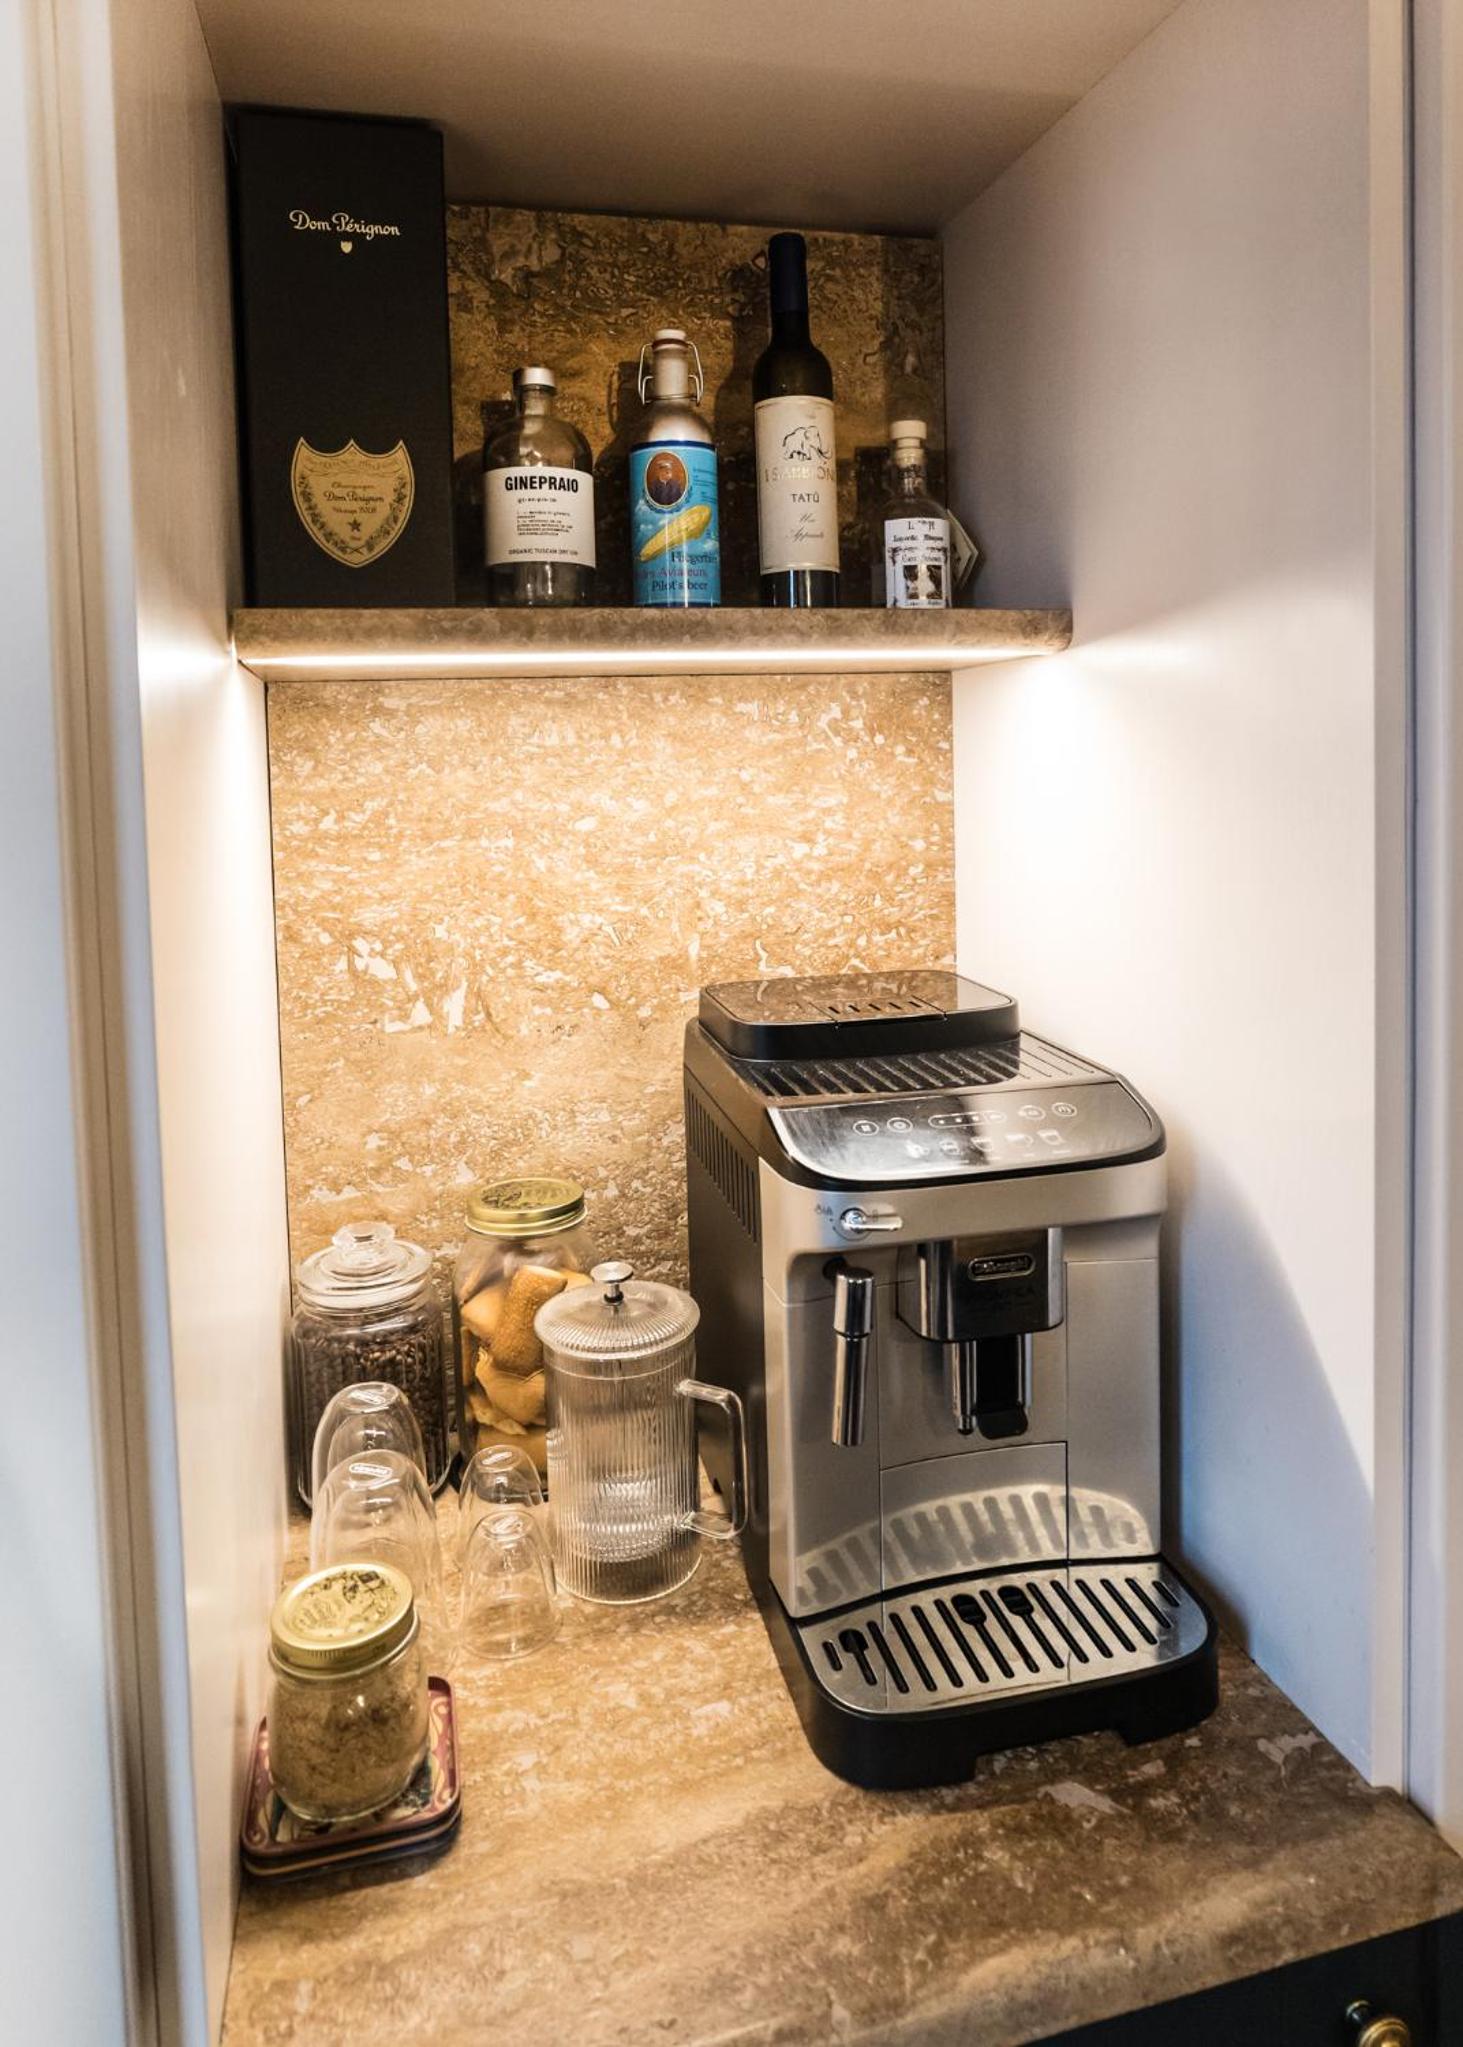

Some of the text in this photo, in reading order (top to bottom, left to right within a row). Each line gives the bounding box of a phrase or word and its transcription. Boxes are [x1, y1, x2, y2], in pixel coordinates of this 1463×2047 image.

[289, 209, 401, 241] Dom Pérignon
[505, 475, 579, 494] GINEPRAIO
[687, 578, 709, 591] beer
